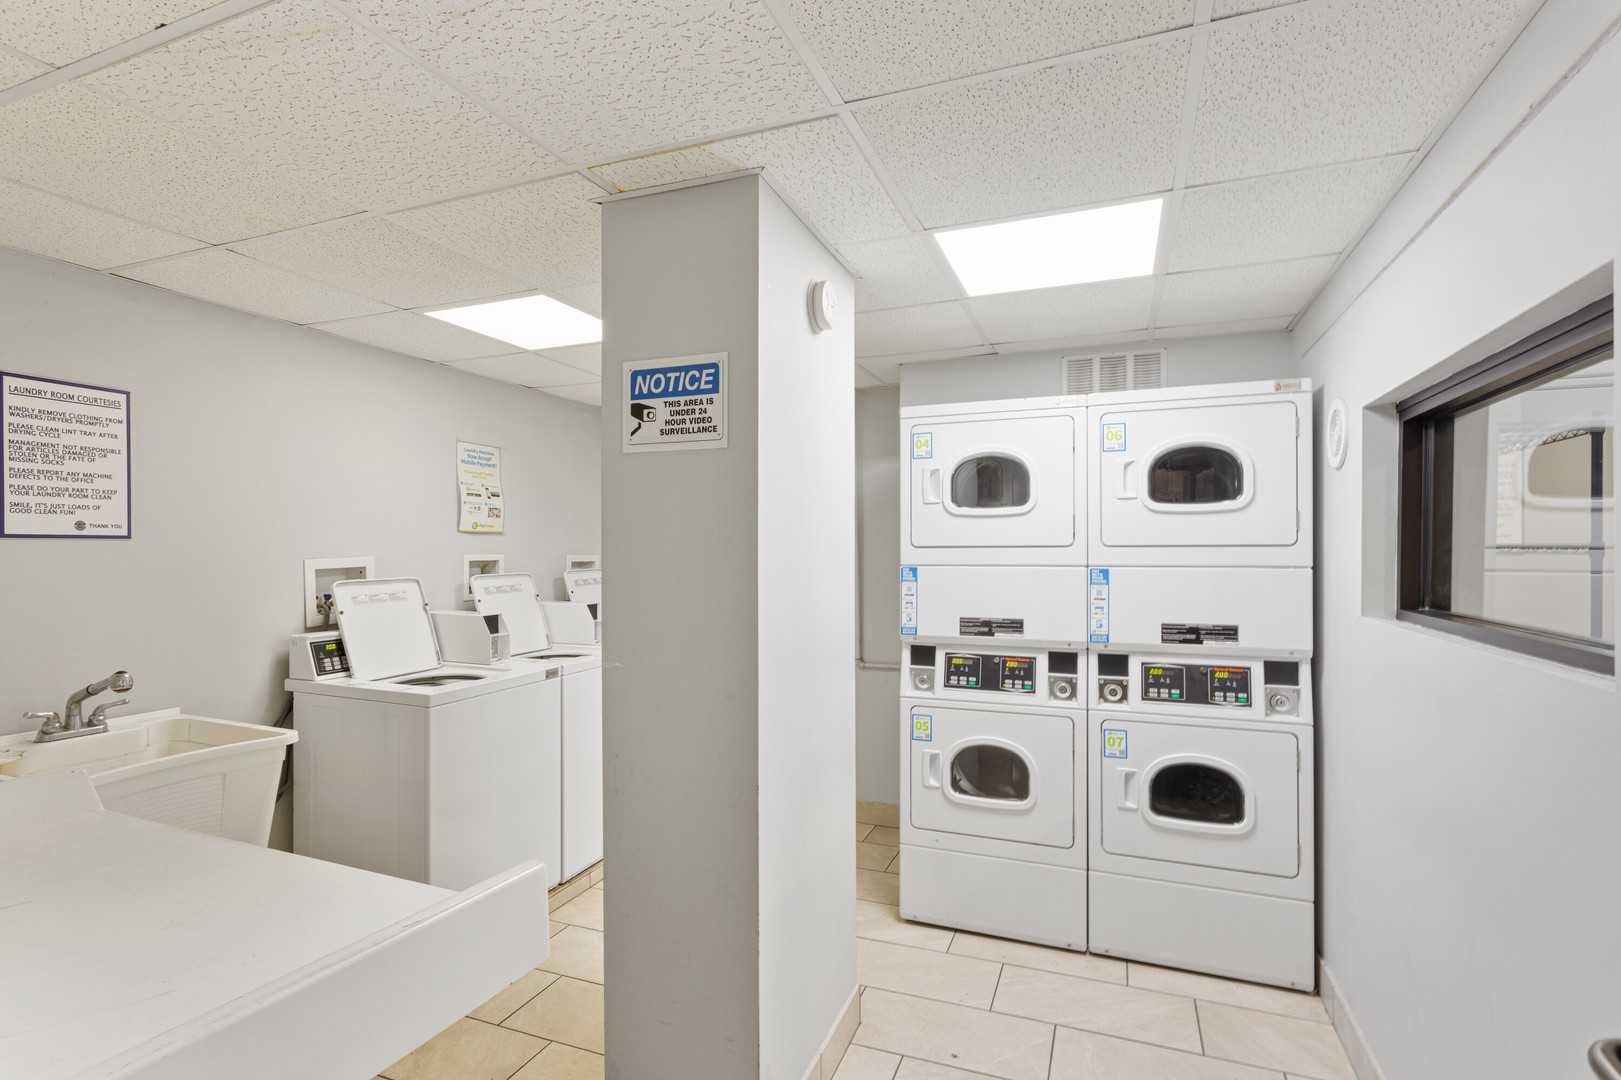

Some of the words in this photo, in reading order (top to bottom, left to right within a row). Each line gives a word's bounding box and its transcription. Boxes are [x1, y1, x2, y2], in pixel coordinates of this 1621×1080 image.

[634, 369, 715, 395] NOTICE
[9, 385, 48, 397] LAUNDRY
[51, 391, 74, 400] ROOM
[77, 395, 121, 407] COURTESIES
[664, 400, 681, 408] THIS
[684, 399, 704, 407] AREA
[9, 405, 35, 413] KINDLY
[38, 409, 66, 417] REMOVE
[69, 413, 103, 422] CLOTHING
[670, 409, 696, 417] UNDER
[9, 411, 73, 424] WASHERS/DRYERS
[75, 420, 109, 428] PROMPTLY
[689, 416, 712, 424] VIDEO
[8, 422, 33, 431] PLEASE
[660, 425, 717, 436] SURVEILLANCE
[1106, 430, 1123, 441] 06
[8, 439, 60, 449] MANAGEMENT
[80, 446, 121, 455] RESPONSIBLE
[915, 439, 930, 450] 04
[26, 446, 59, 454] ARTICLES
[62, 450, 96, 458] DAMAGED
[915, 721, 928, 731] 05
[1107, 736, 1124, 747] 07
